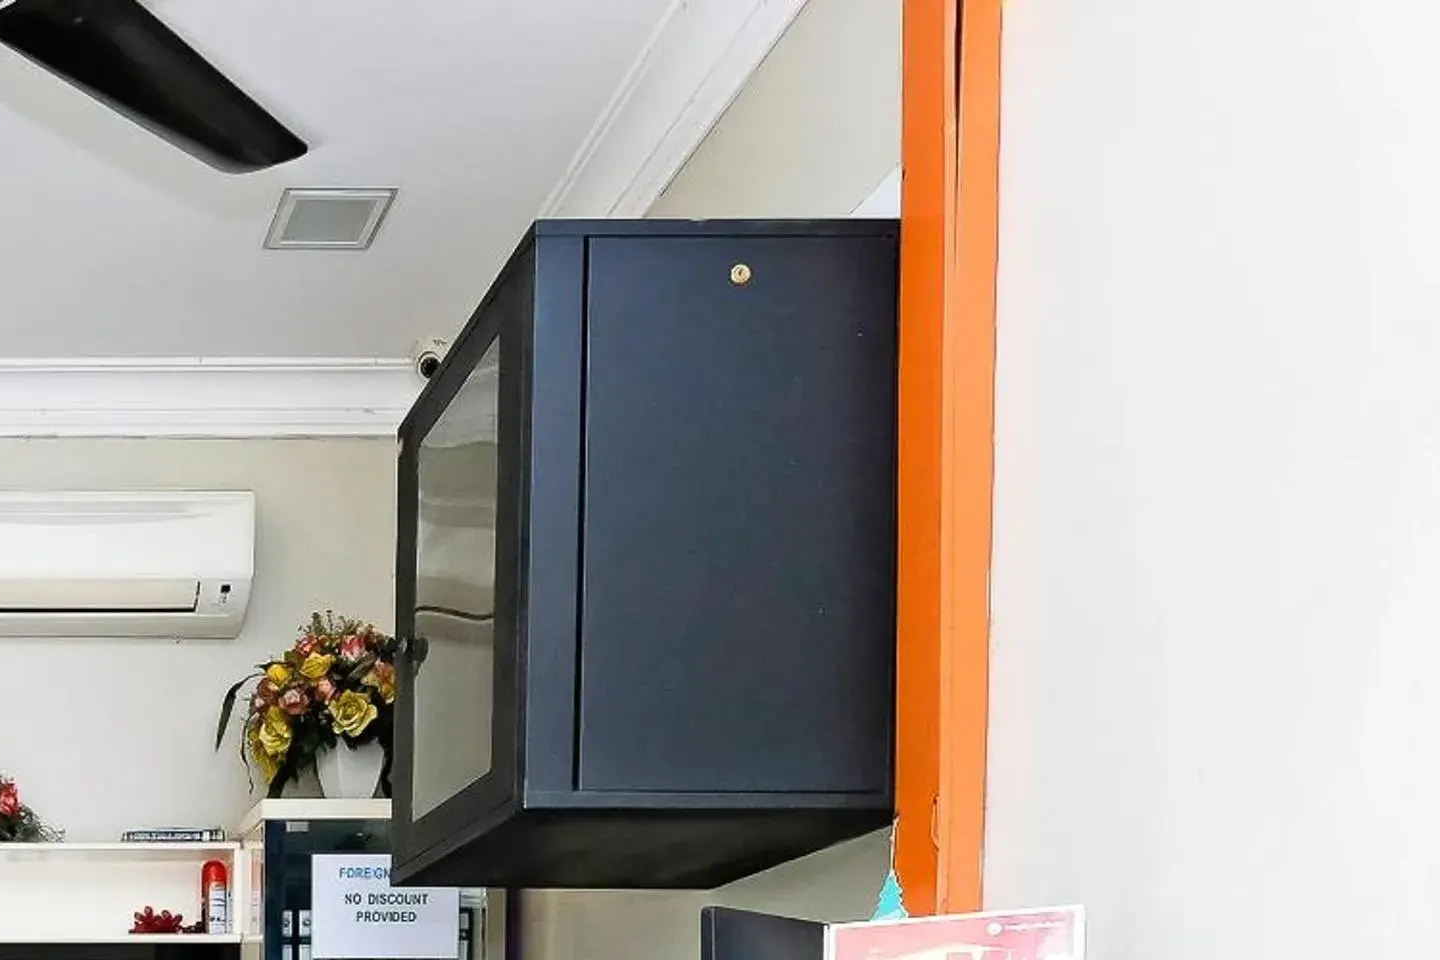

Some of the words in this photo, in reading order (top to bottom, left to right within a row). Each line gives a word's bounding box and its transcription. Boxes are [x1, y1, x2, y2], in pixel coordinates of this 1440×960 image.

[344, 893, 362, 905] NO
[368, 893, 429, 905] DISCOUNT
[356, 911, 418, 923] PROVIDED
